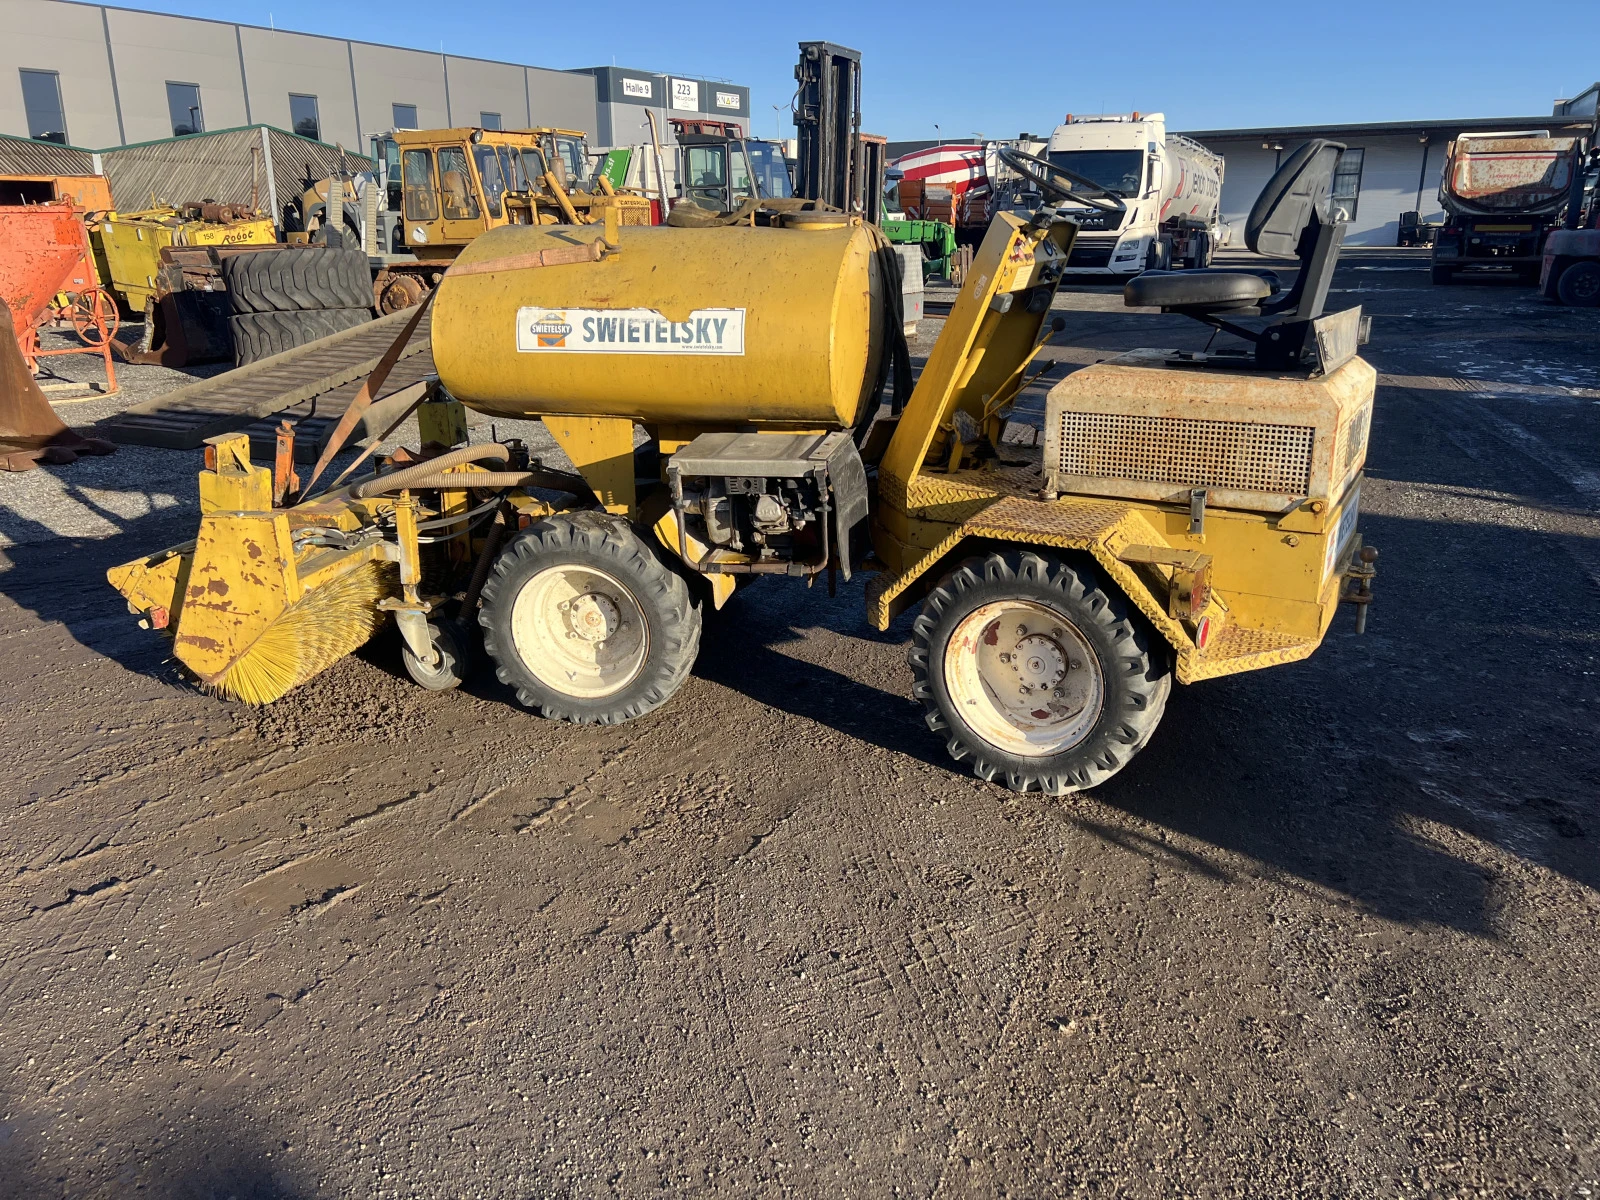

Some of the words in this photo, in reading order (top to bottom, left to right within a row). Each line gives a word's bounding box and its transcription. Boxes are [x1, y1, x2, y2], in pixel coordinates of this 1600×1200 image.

[626, 82, 643, 93] Halle
[645, 85, 649, 94] 9
[677, 84, 691, 95] 223
[203, 232, 214, 240] 158
[222, 230, 254, 245] Robot
[531, 324, 571, 334] SWIETELSKY
[582, 316, 728, 344] SWIETELSKY
